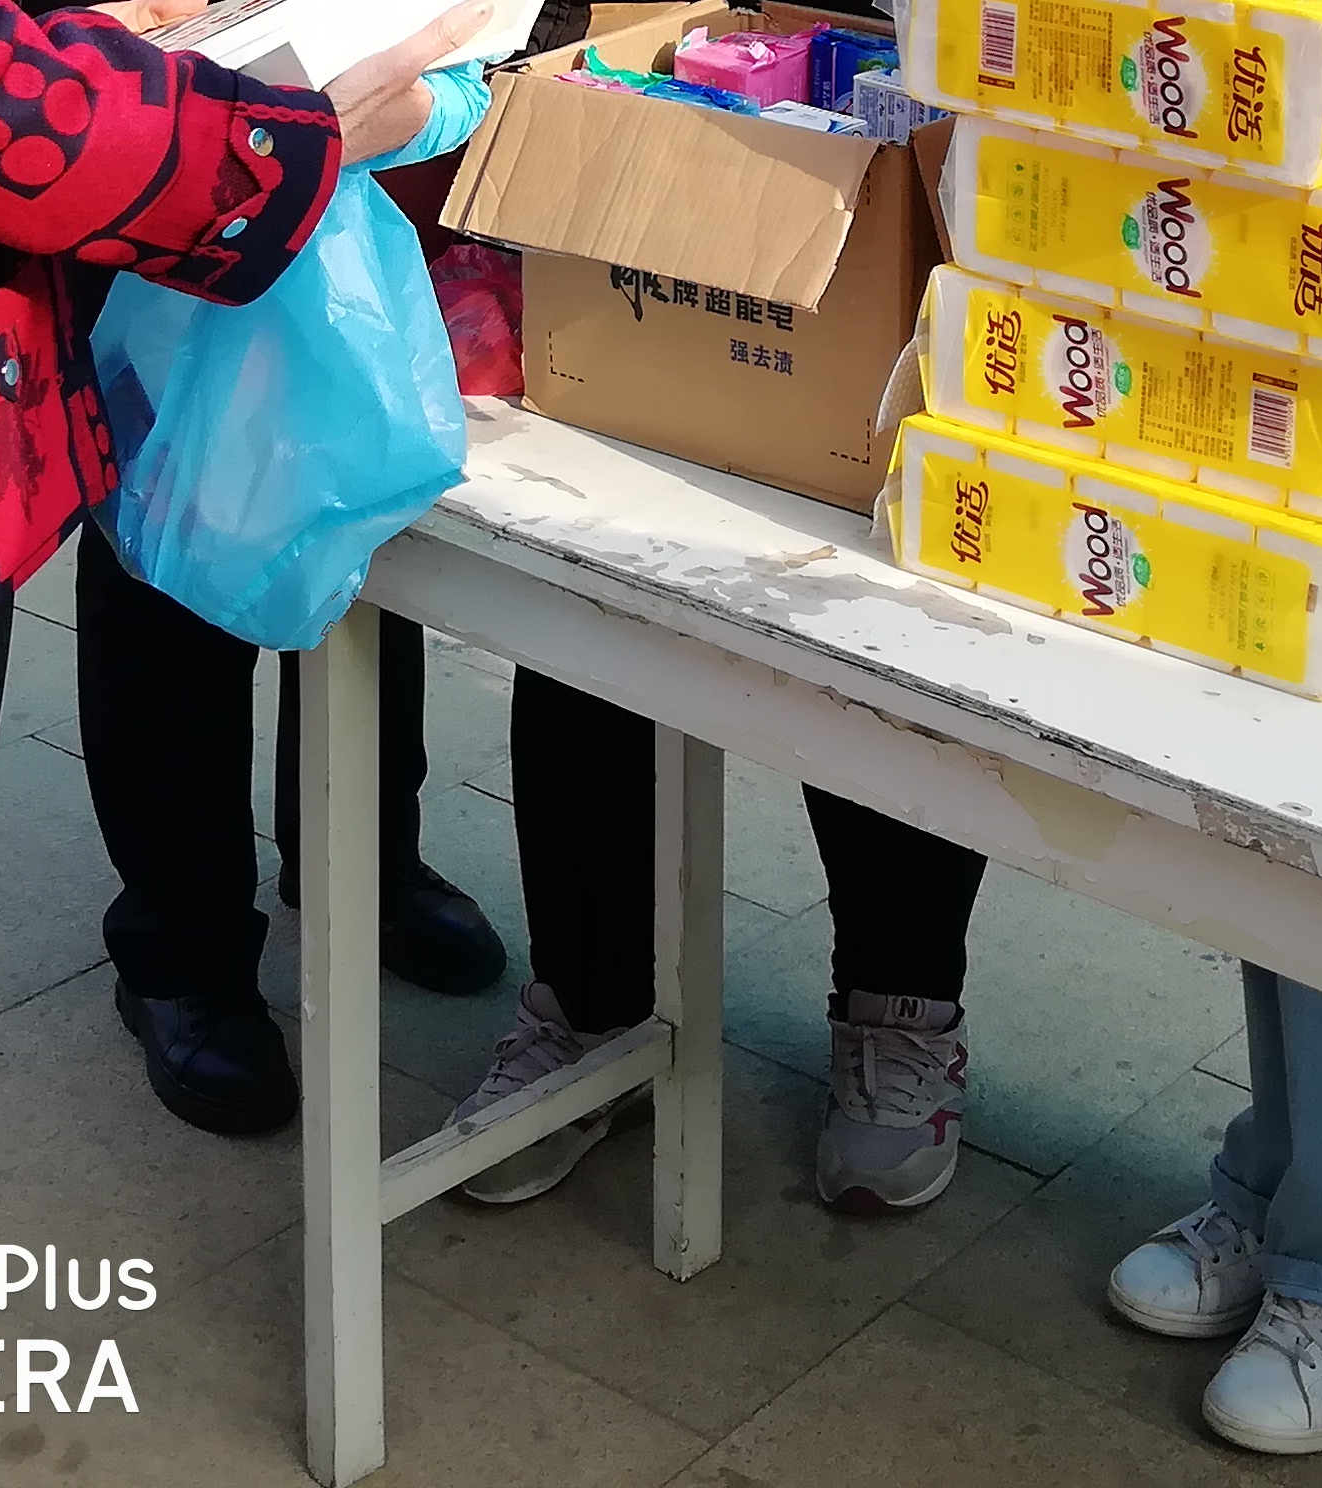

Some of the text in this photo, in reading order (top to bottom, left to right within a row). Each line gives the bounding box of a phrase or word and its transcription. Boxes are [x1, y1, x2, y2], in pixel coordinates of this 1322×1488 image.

[1152, 15, 1198, 140] Wood
[1157, 177, 1203, 299] Wood
[729, 338, 794, 377] 强去渍
[1051, 313, 1097, 430] Wood
[1071, 502, 1116, 618] Wood
